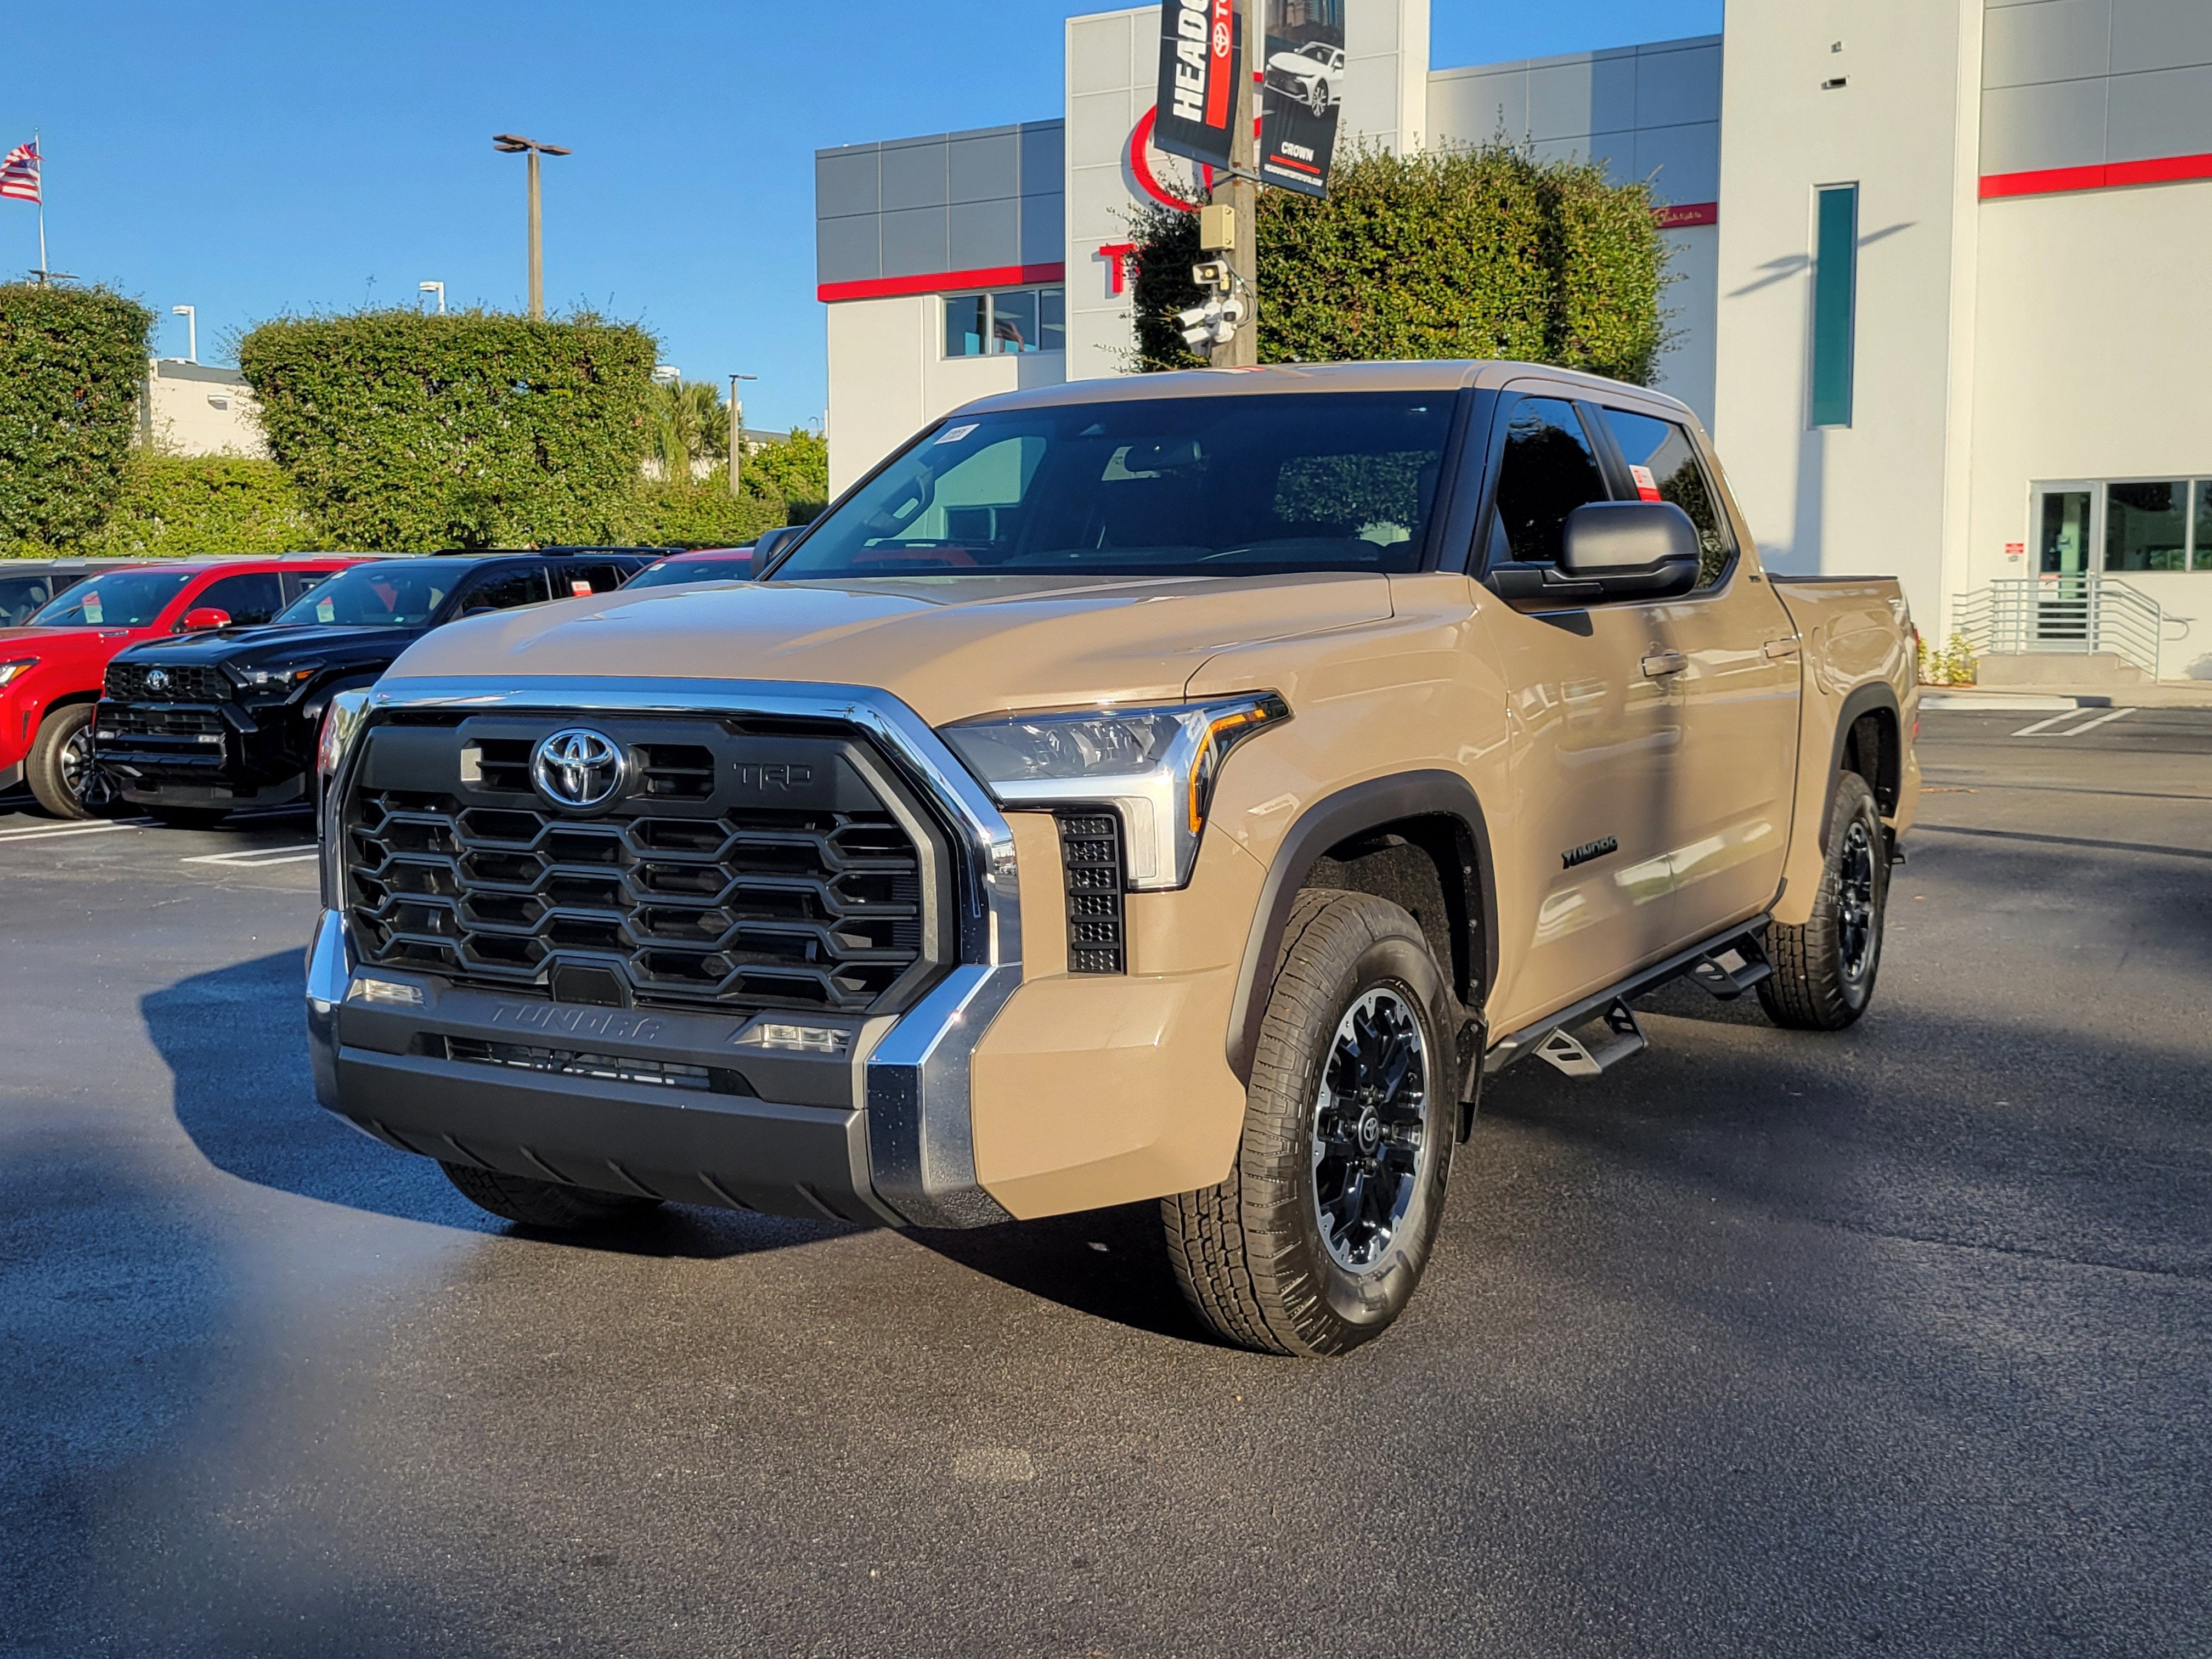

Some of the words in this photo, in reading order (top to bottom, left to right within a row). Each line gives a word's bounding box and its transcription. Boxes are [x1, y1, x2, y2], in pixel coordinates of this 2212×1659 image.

[1281, 141, 1314, 162] CROWN
[733, 763, 812, 791] TRD
[493, 1001, 665, 1041] TUNDRA
